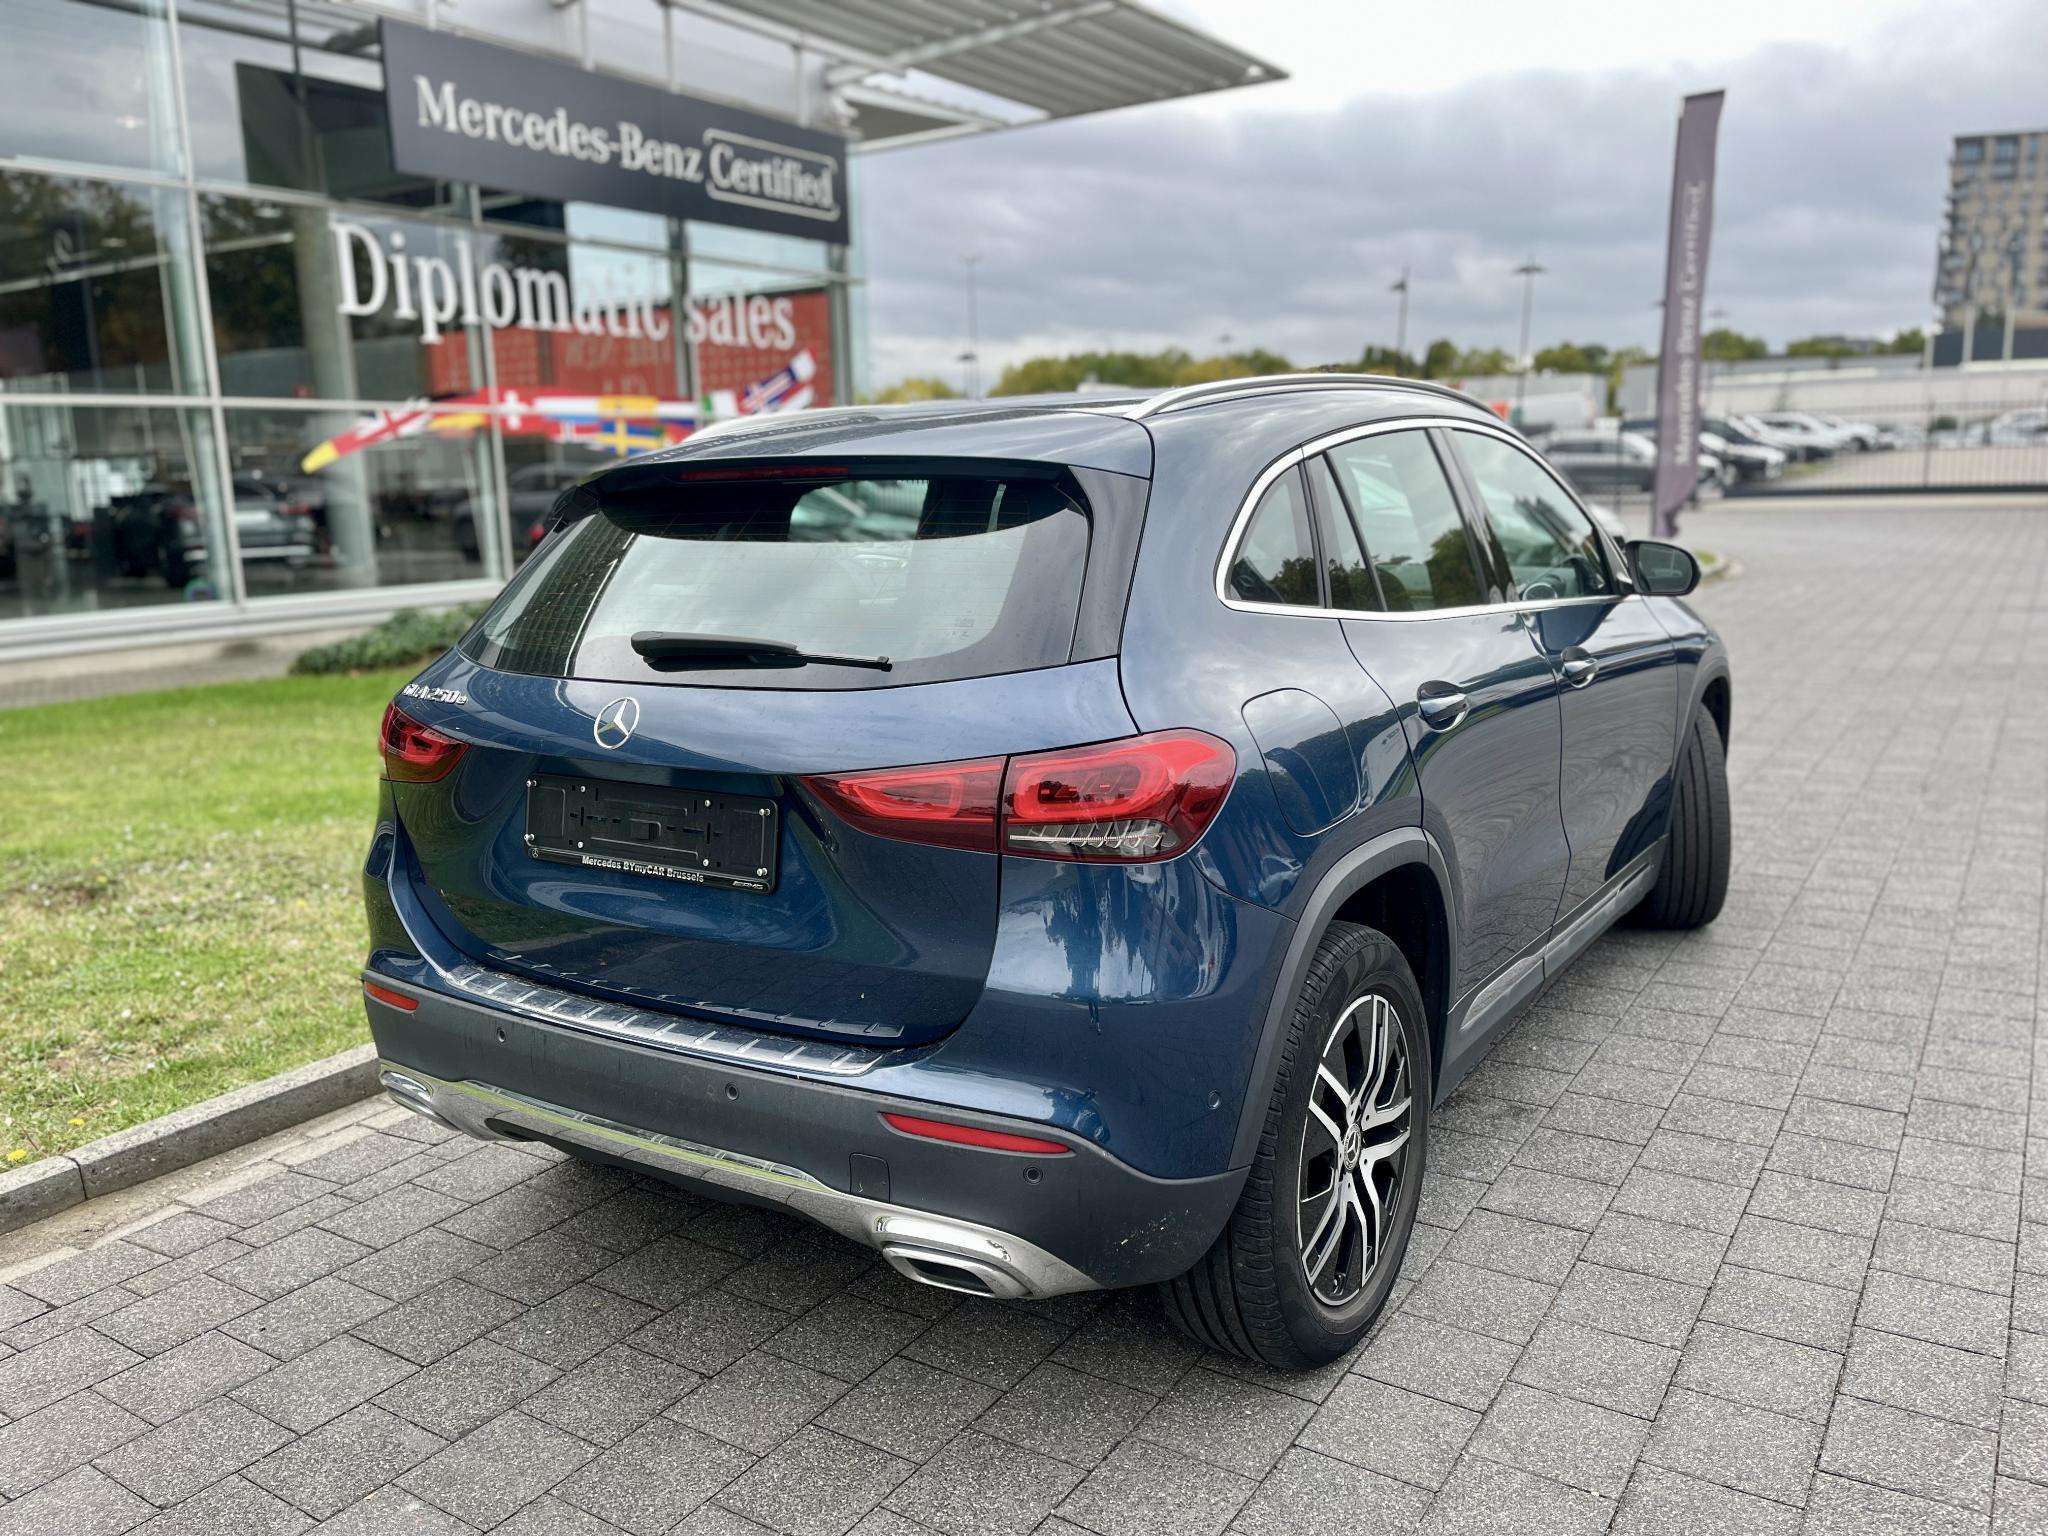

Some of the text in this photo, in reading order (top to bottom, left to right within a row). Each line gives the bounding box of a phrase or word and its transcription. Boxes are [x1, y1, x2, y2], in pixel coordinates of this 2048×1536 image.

[415, 76, 834, 209] Mercedes-Benz Certified
[330, 222, 796, 350] Diplomatic sales
[581, 855, 621, 870] Mercedes
[666, 867, 704, 883] Brussels
